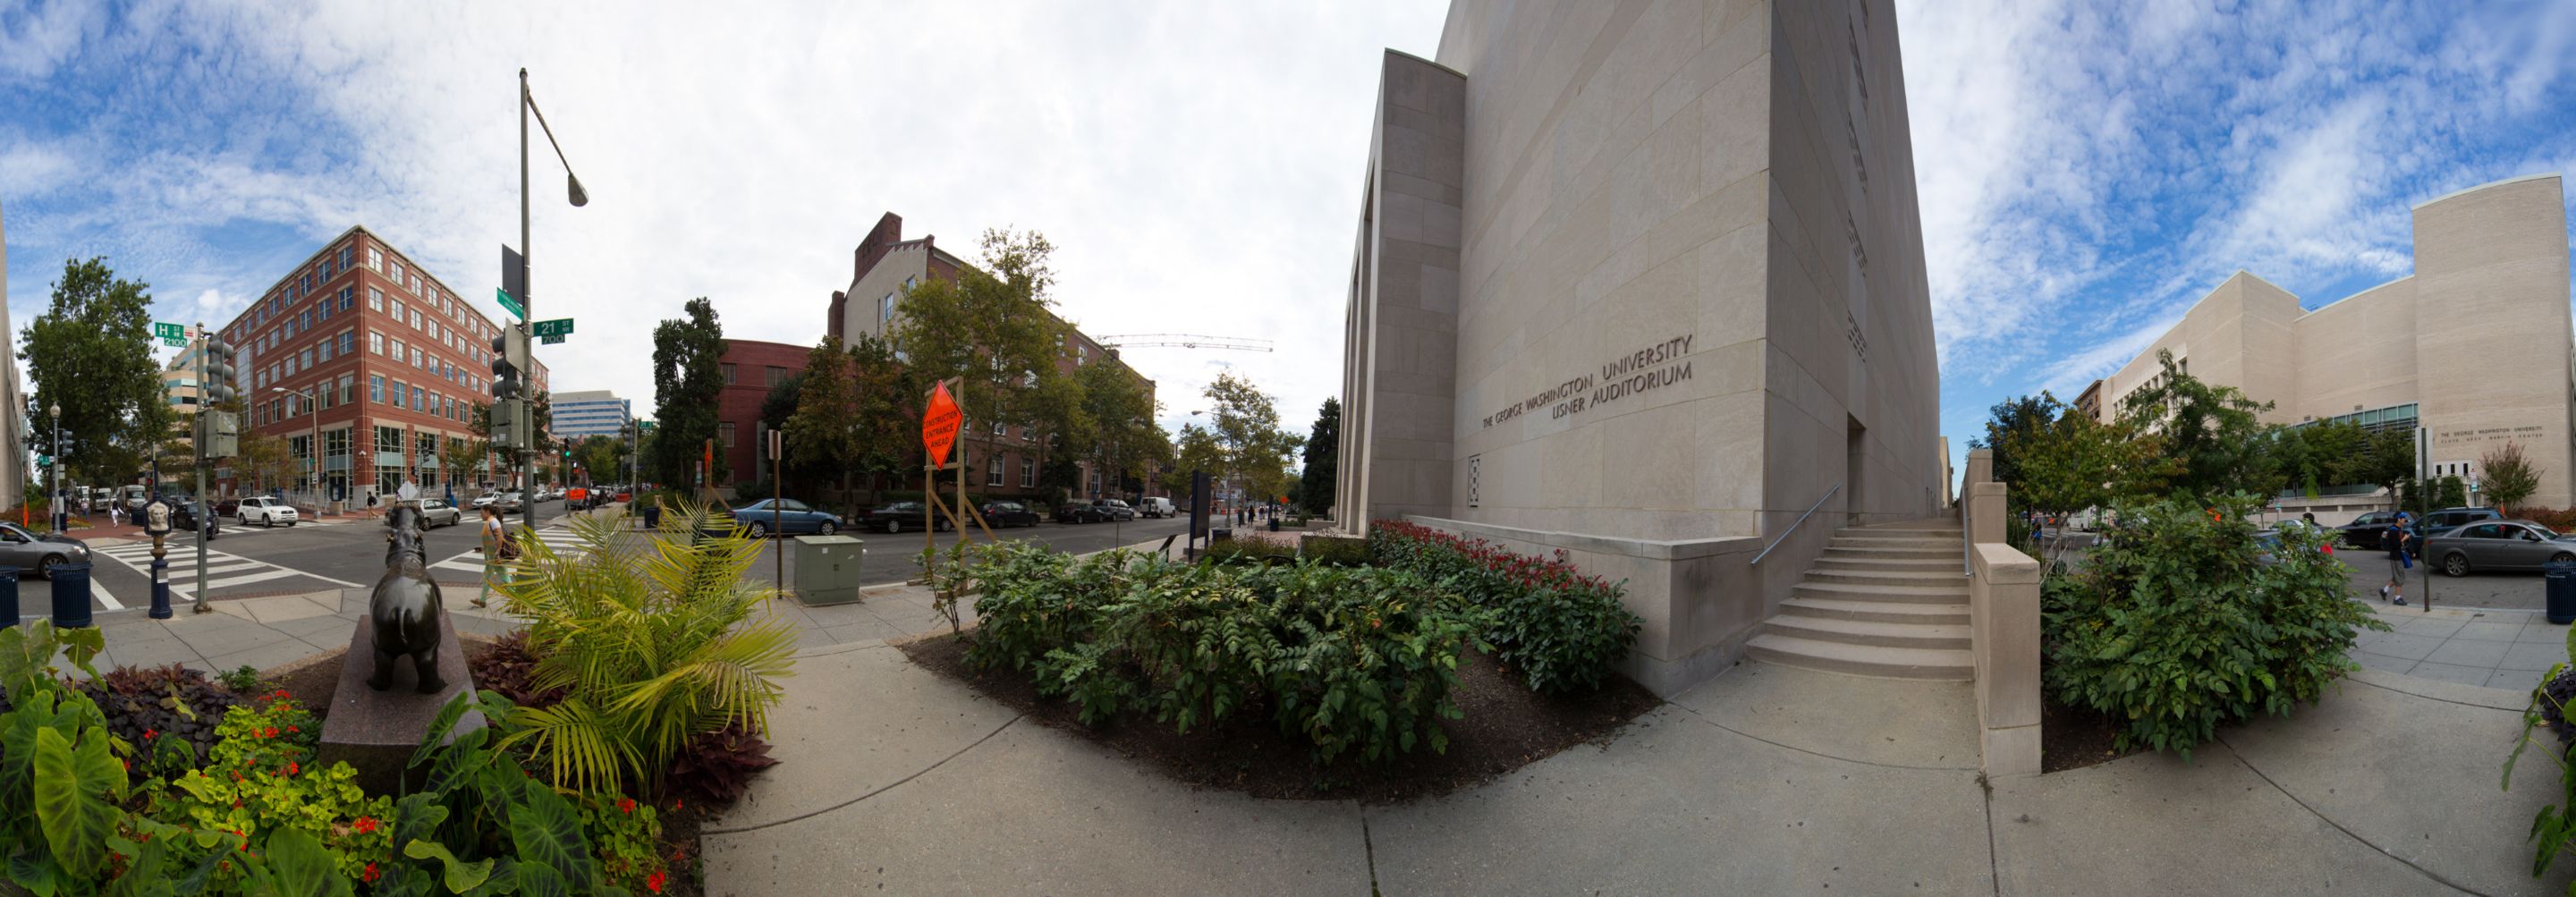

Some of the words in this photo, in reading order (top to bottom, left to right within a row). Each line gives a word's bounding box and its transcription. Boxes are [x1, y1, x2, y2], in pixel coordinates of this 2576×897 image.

[159, 324, 168, 335] H
[541, 323, 555, 334] 21
[165, 338, 187, 347] 2100
[544, 334, 564, 344] 700
[1483, 415, 1493, 429] THE
[1496, 402, 1522, 424] GEORGE
[1526, 373, 1593, 411] WASHINGTON
[1602, 334, 1693, 380] UNIVERSITY
[1552, 397, 1585, 419] LISNER
[1589, 361, 1692, 409] AUDITORIUM
[923, 410, 958, 428] CONSTRUCTION
[925, 423, 953, 438] ENTRANCE
[930, 436, 950, 447] AHEAD
